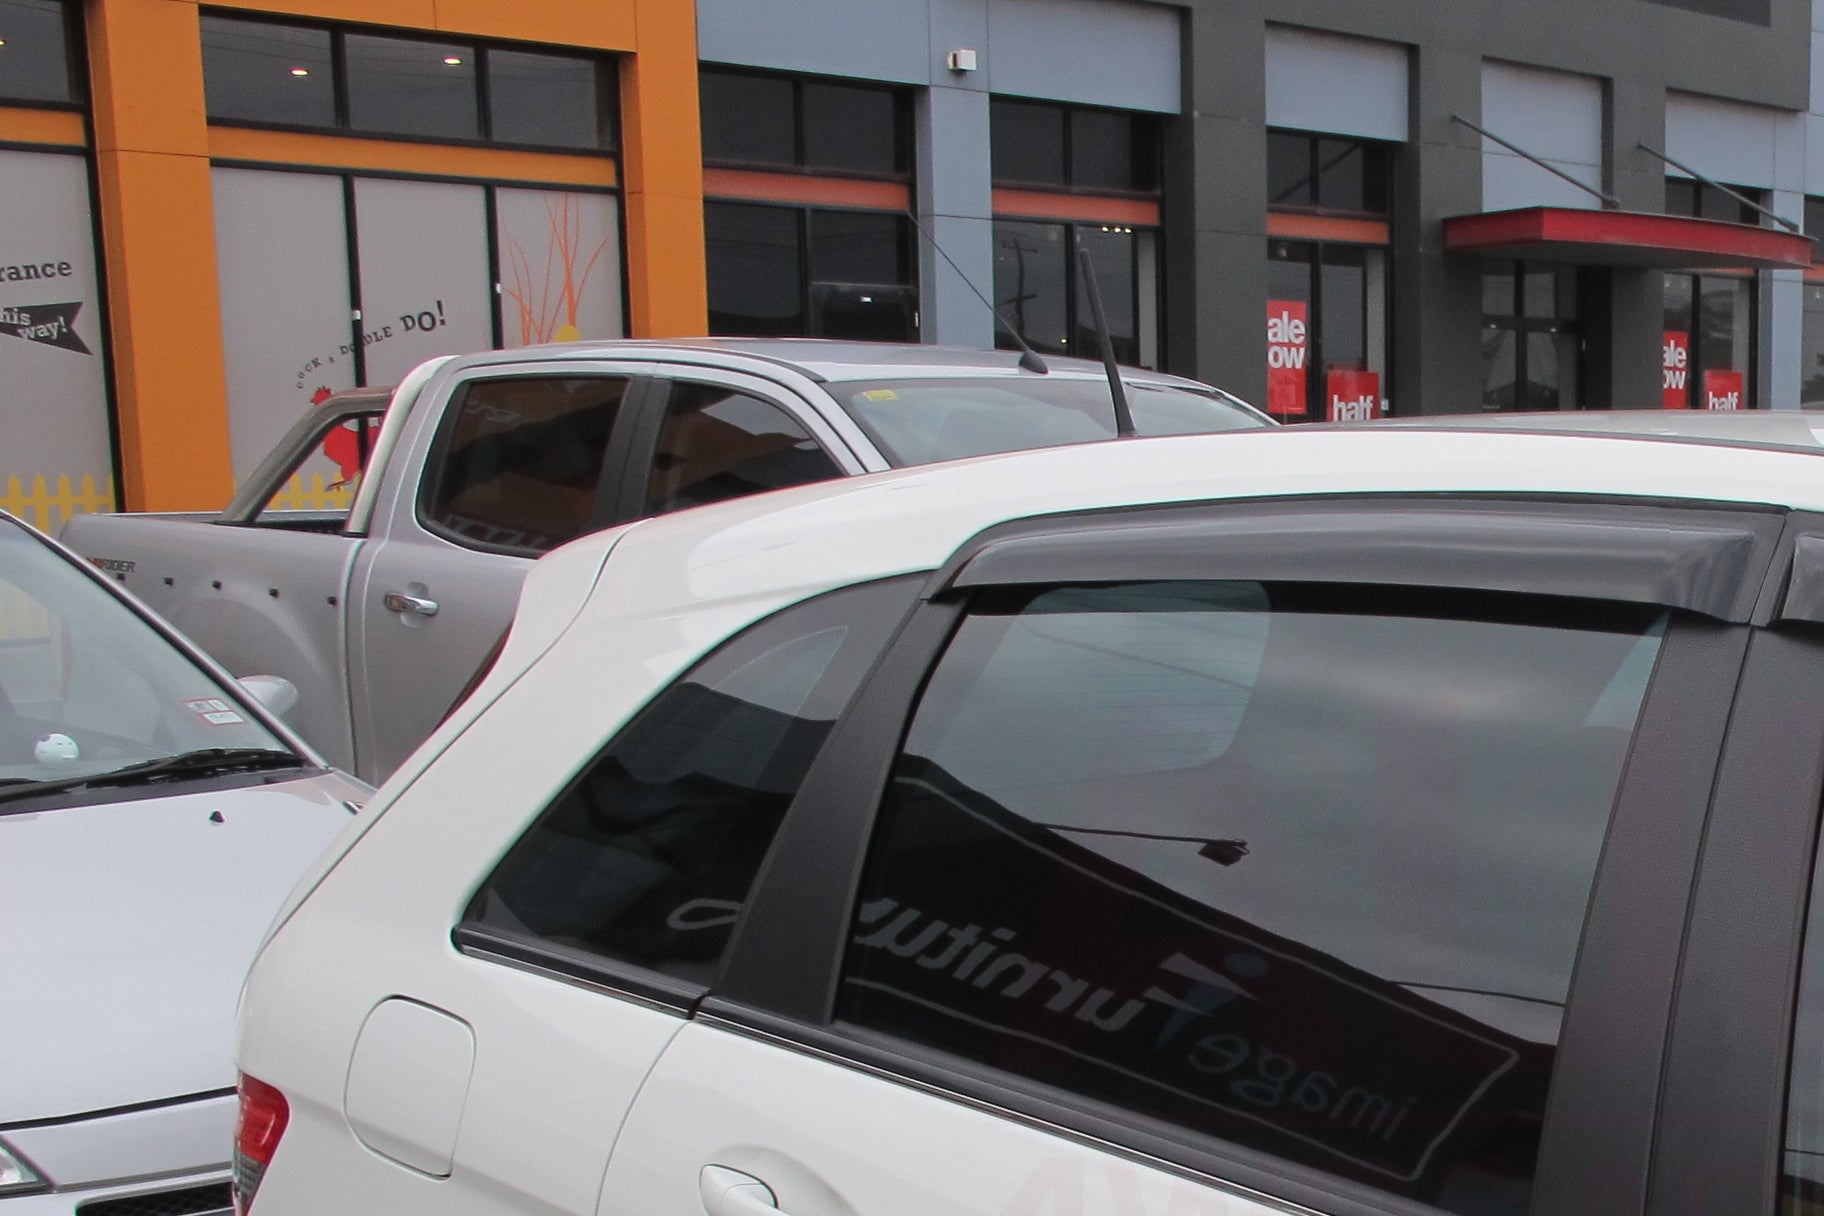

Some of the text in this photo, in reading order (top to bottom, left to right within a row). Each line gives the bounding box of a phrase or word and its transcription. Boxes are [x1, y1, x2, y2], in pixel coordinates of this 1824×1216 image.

[18, 315, 68, 340] way!
[400, 299, 446, 332] DO!
[1333, 394, 1374, 422] half
